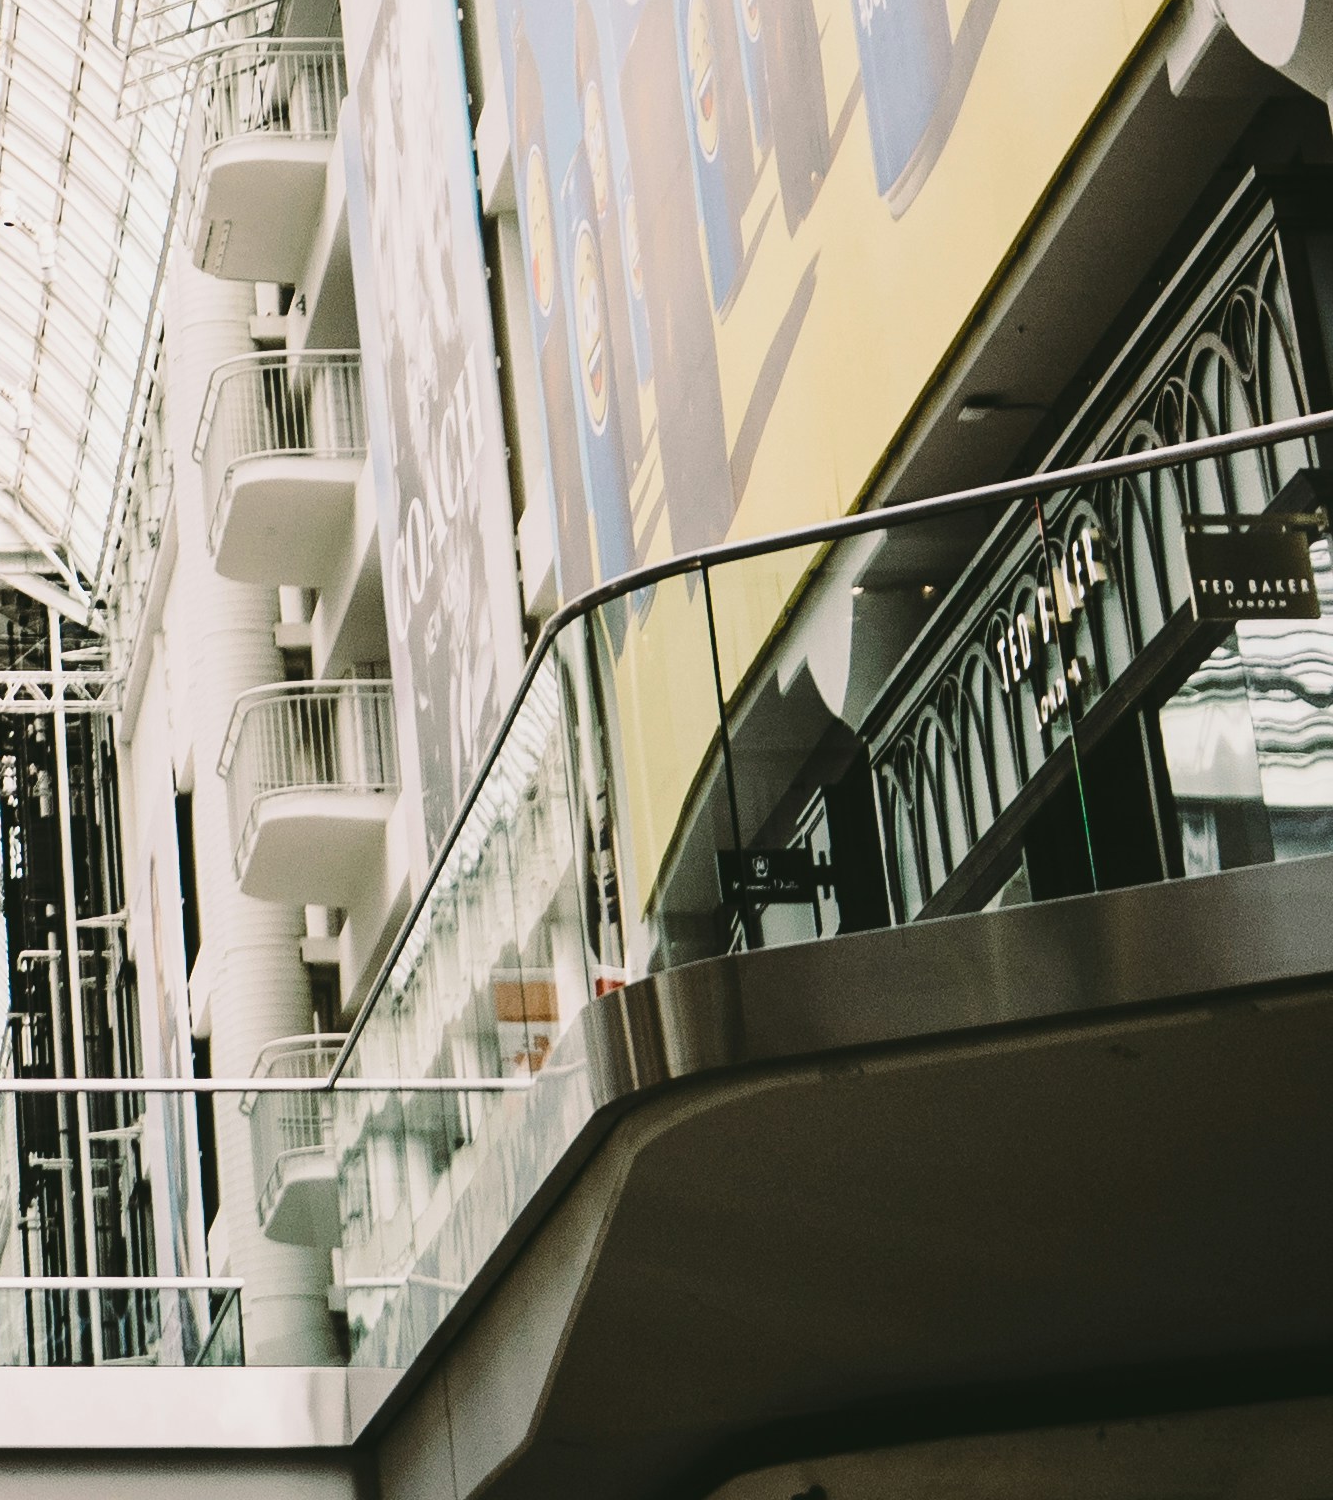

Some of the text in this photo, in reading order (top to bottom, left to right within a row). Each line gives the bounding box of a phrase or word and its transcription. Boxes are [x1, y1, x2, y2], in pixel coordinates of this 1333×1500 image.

[392, 341, 485, 643] COACH
[1038, 528, 1104, 643] BKER
[1200, 579, 1310, 595] TED BAKER
[1228, 599, 1288, 609] LONDON
[997, 613, 1032, 692] TED
[1035, 659, 1082, 732] LONDN
